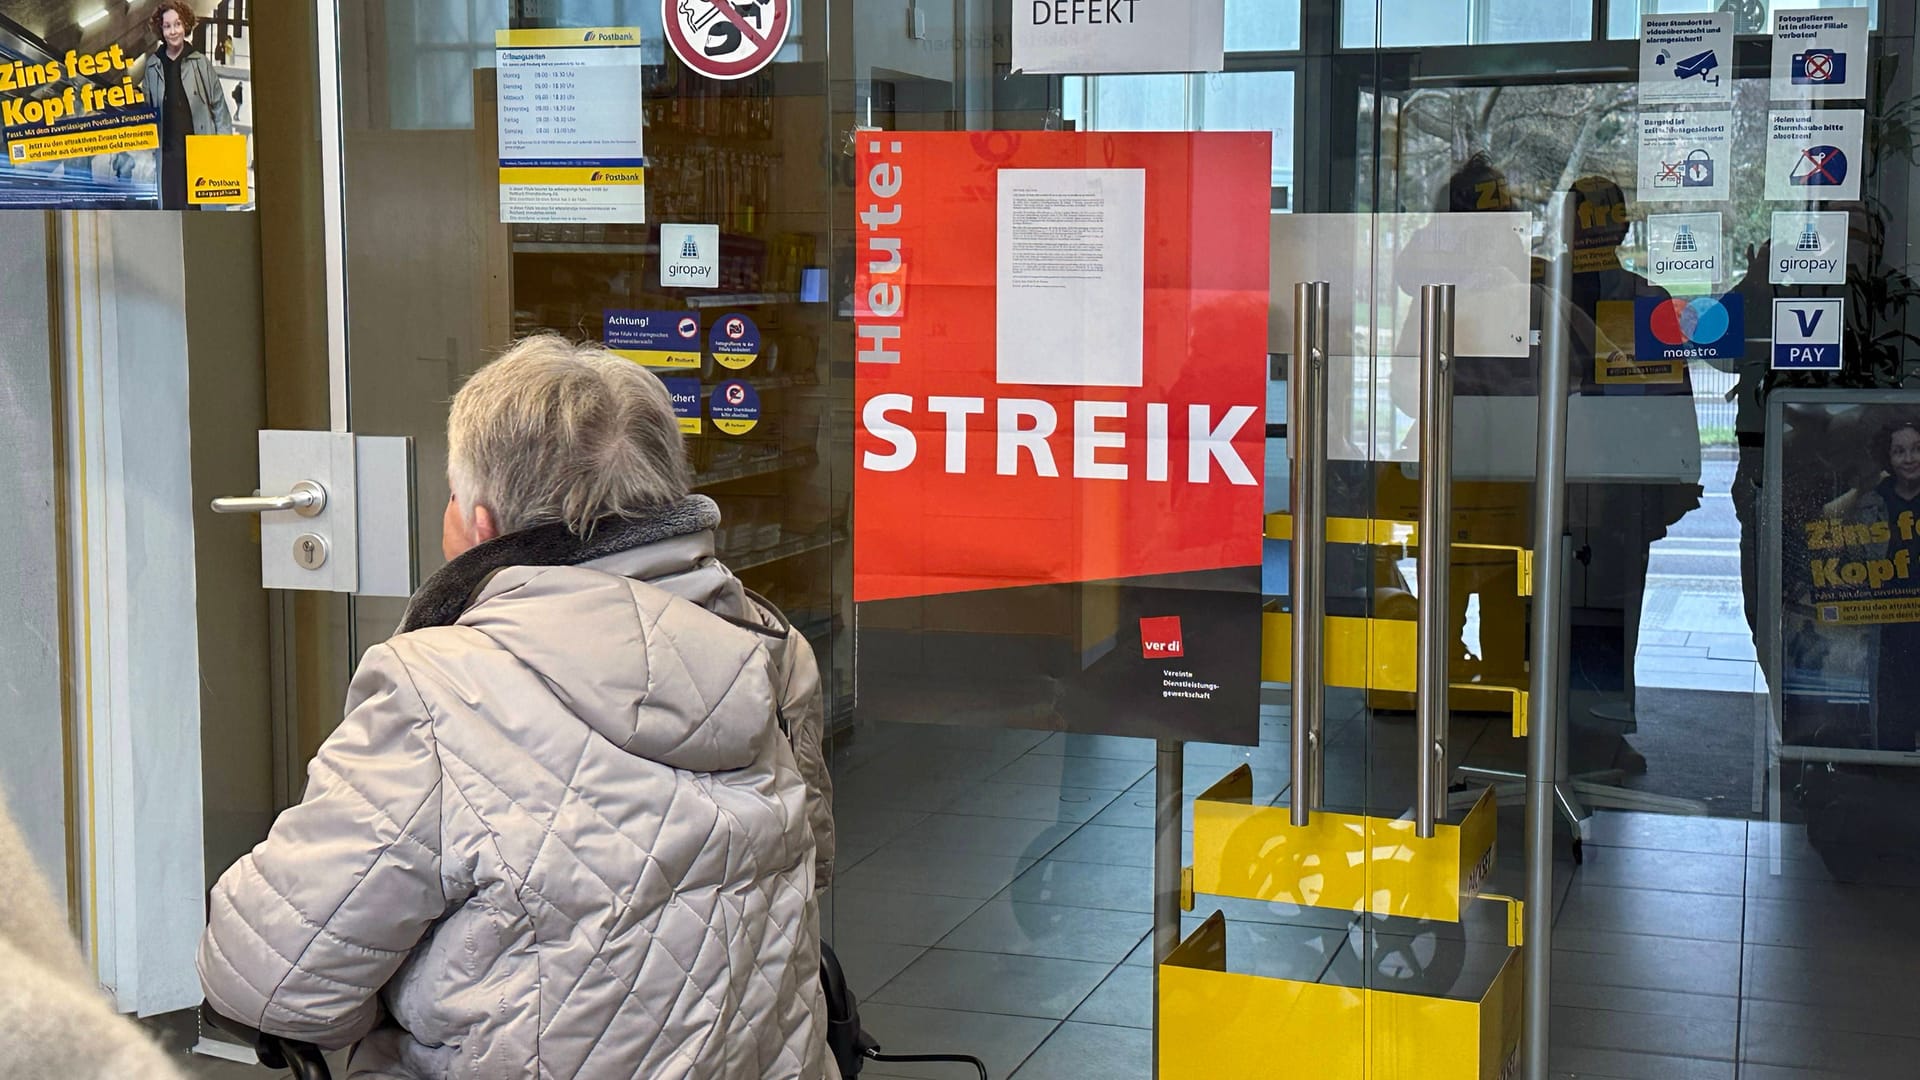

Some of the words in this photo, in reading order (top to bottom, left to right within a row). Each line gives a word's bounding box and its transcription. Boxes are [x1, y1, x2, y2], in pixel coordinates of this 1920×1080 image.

[1033, 0, 1141, 25] DEFEKT
[1779, 15, 1834, 23] Fotografieren
[1669, 19, 1702, 27] Standort
[1702, 18, 1713, 26] ist
[1778, 23, 1788, 31] ist
[1789, 23, 1798, 31] in
[1823, 22, 1848, 30] Filiale
[598, 32, 634, 41] Postbank
[1778, 31, 1818, 39] verboten!
[0, 61, 63, 92] Zins
[64, 43, 136, 79] fest.
[2, 88, 75, 127] Kopf
[81, 76, 145, 111] frei.
[605, 173, 639, 182] Postbank
[857, 140, 903, 365] Heute:
[668, 262, 713, 279] giropay
[1655, 256, 1715, 275] girocard
[1780, 257, 1838, 274] giropay
[608, 315, 650, 329] Achtung!
[1788, 309, 1825, 338] V
[1664, 347, 1717, 358] maestro
[1790, 347, 1825, 362] PAY
[862, 392, 1259, 487] STREIK
[1804, 520, 1891, 551] Zins
[1811, 548, 1911, 589] Kopf
[1163, 670, 1194, 678] Vereinte
[1163, 680, 1221, 691] Dienstleistungs-
[1162, 690, 1211, 700] gewerkschaft
